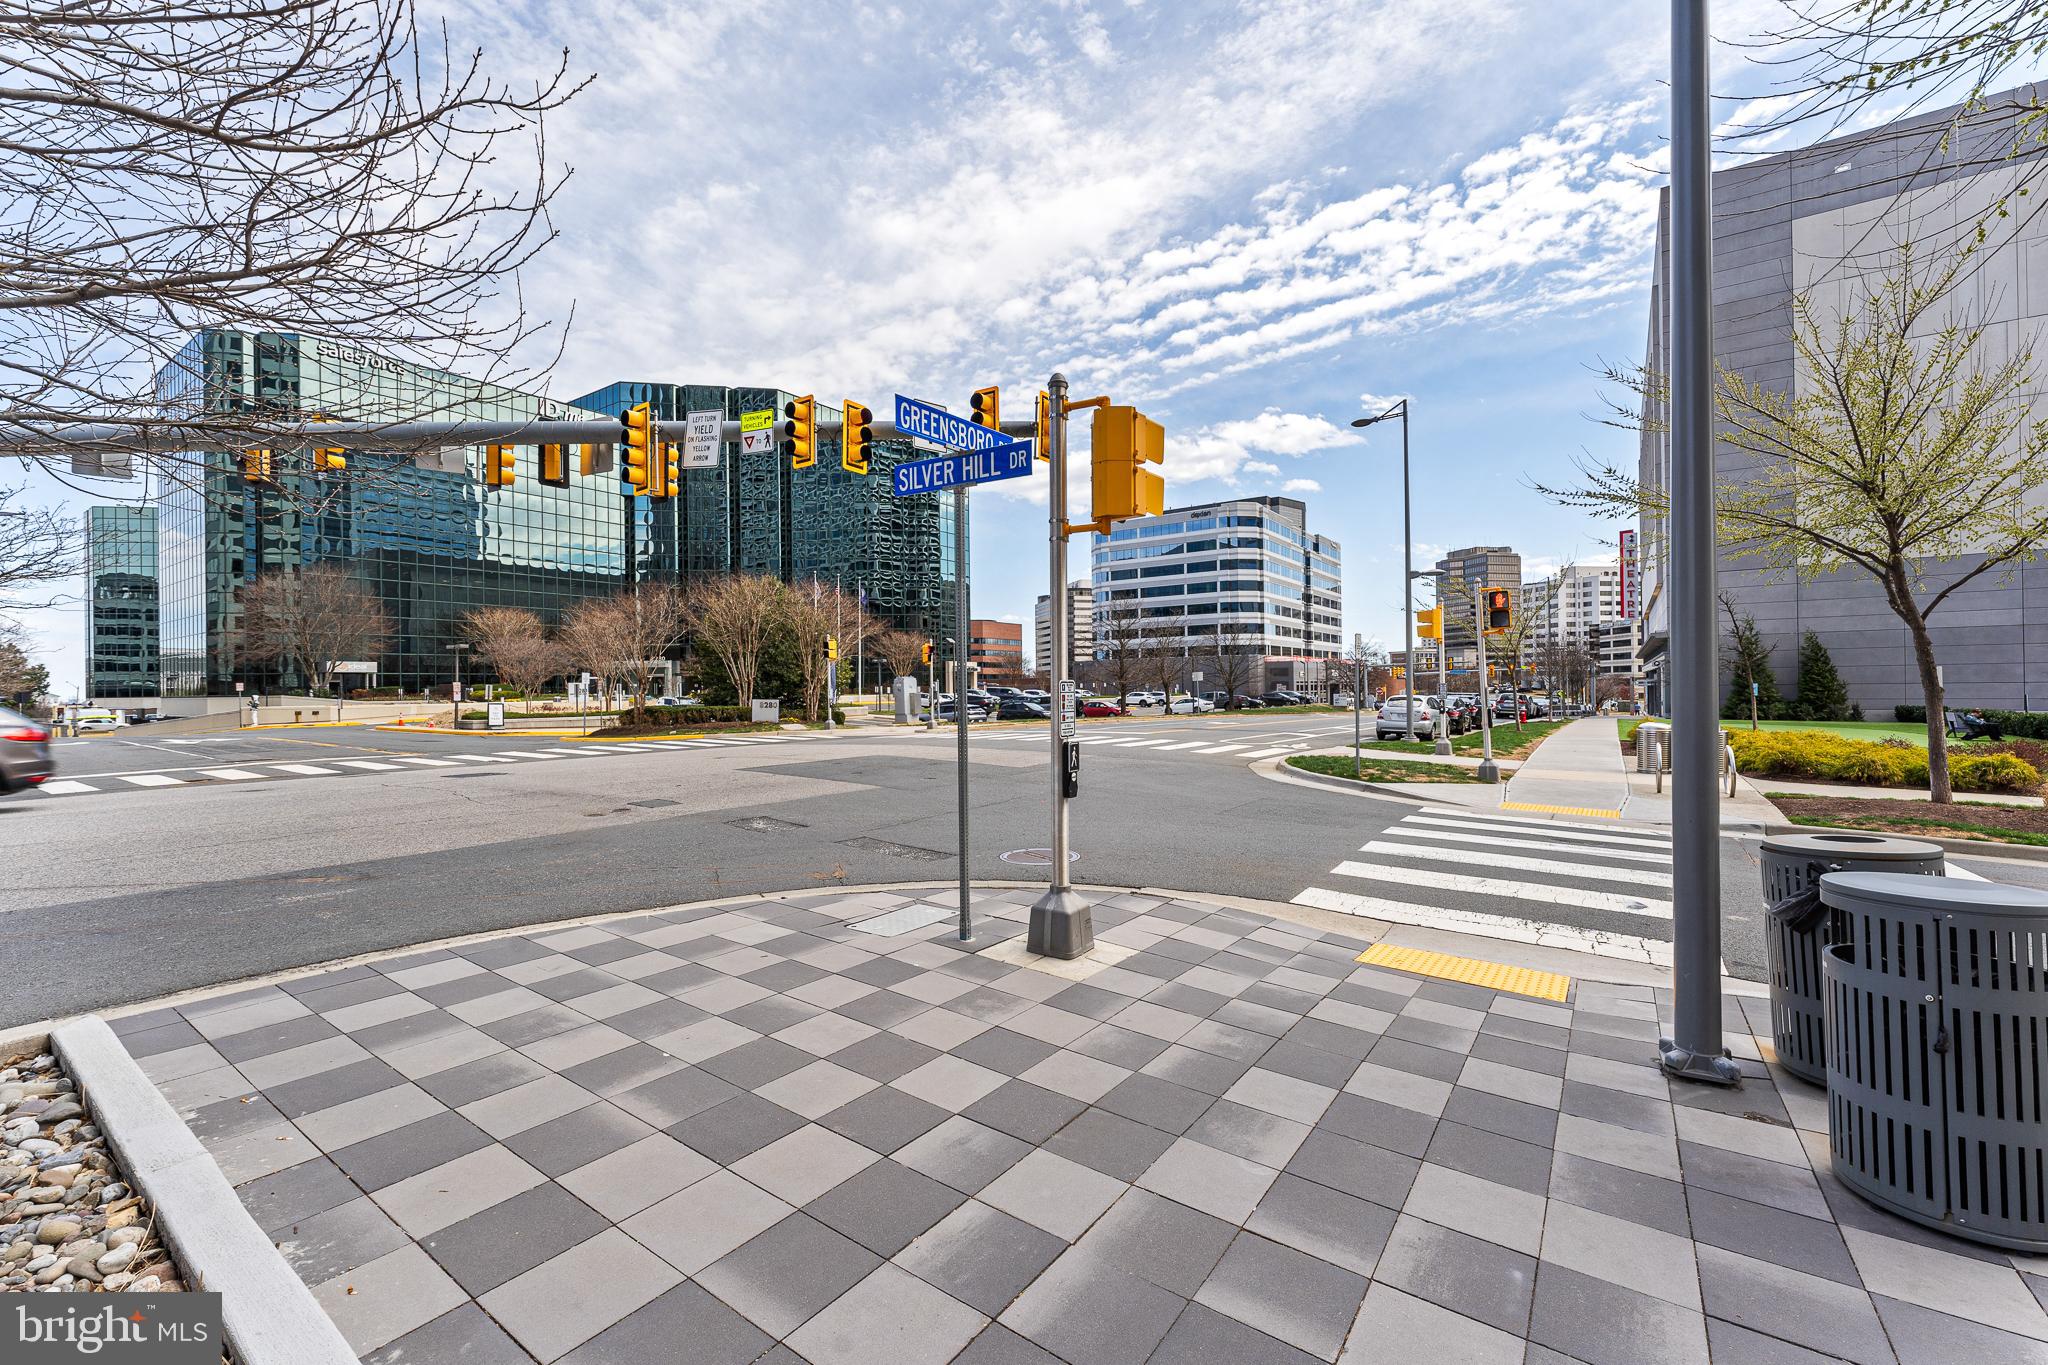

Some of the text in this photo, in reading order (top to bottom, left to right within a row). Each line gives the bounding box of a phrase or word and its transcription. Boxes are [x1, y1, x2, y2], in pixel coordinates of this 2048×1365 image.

[317, 343, 405, 375] salesforce
[694, 425, 713, 434] YIELD
[900, 402, 994, 450] GREENSBORO
[899, 450, 1027, 492] SILVER HILL DR
[1626, 549, 1635, 618] THEATRE
